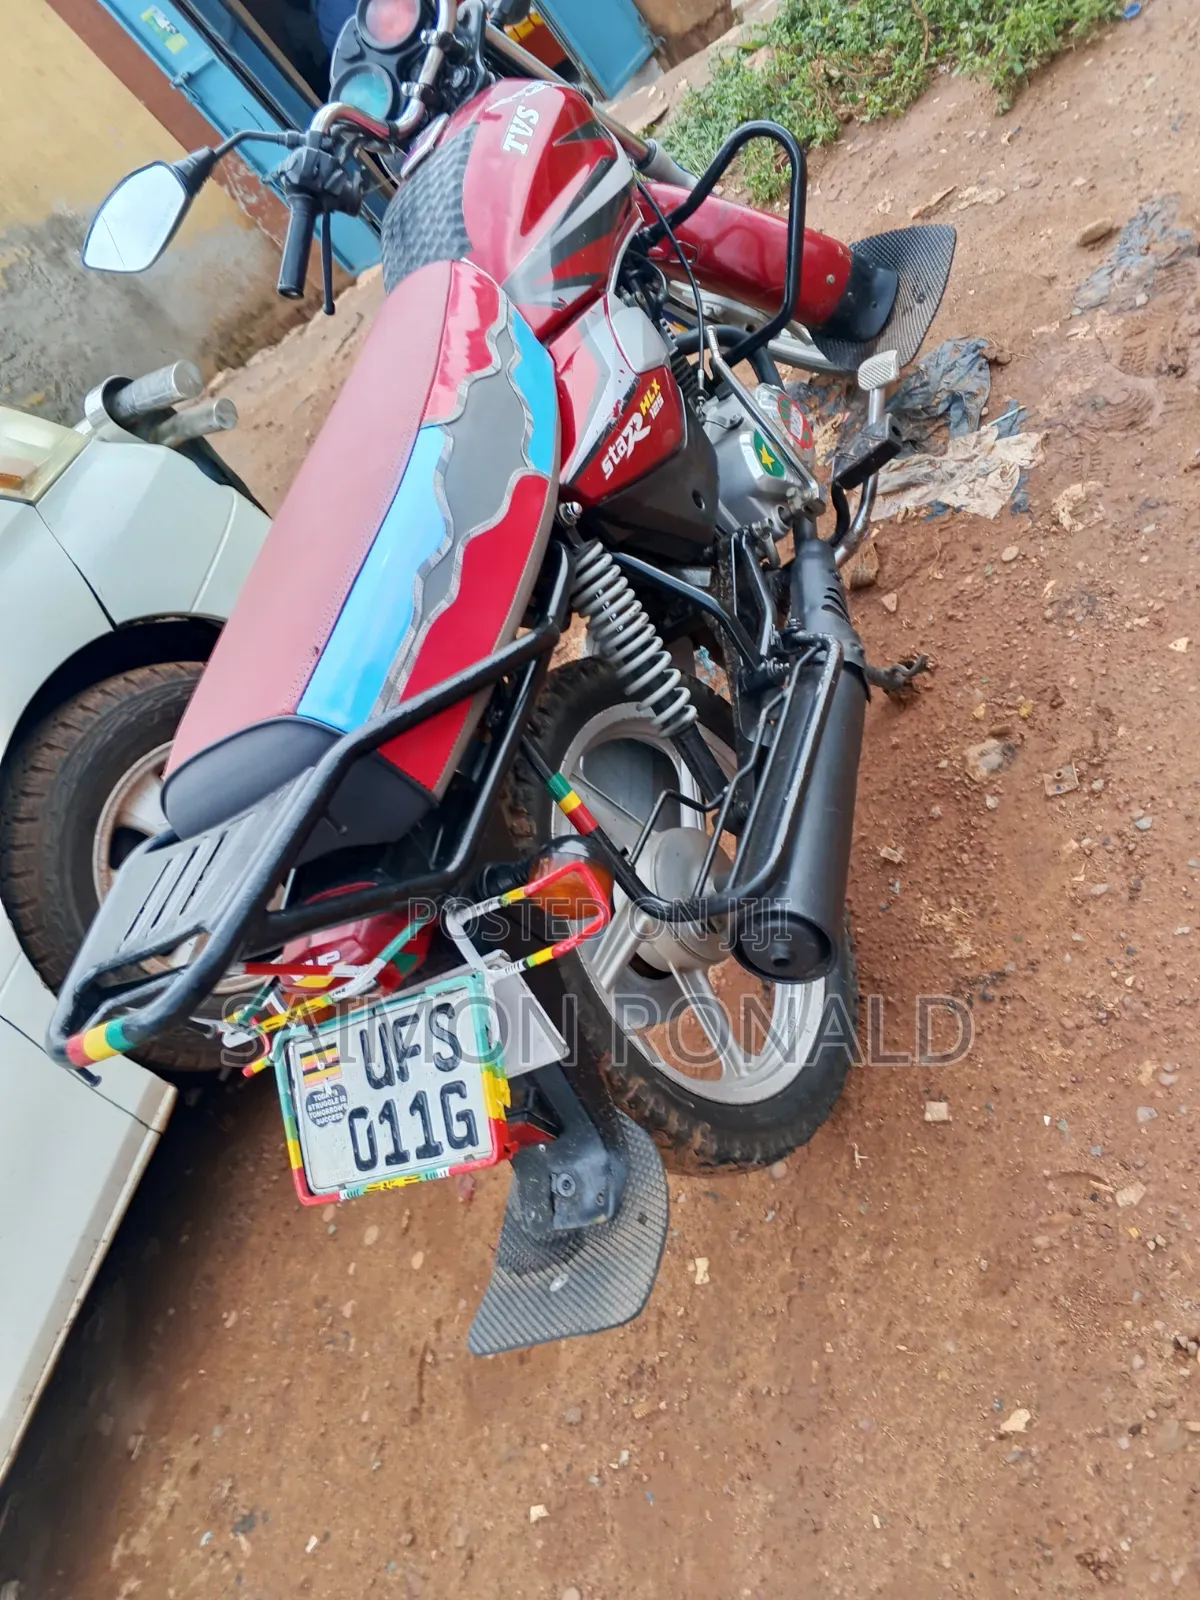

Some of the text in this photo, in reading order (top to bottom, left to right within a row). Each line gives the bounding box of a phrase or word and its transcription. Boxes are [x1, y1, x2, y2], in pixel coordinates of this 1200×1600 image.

[502, 105, 540, 156] TVS
[640, 378, 661, 416] HLX
[649, 392, 665, 420] 125
[360, 1003, 462, 1090] UFS
[308, 1095, 347, 1111] STRUGGLE IS
[309, 1103, 348, 1119] TOMORROW'S
[316, 1112, 344, 1125] SUCCESS
[348, 1080, 480, 1172] 011G
